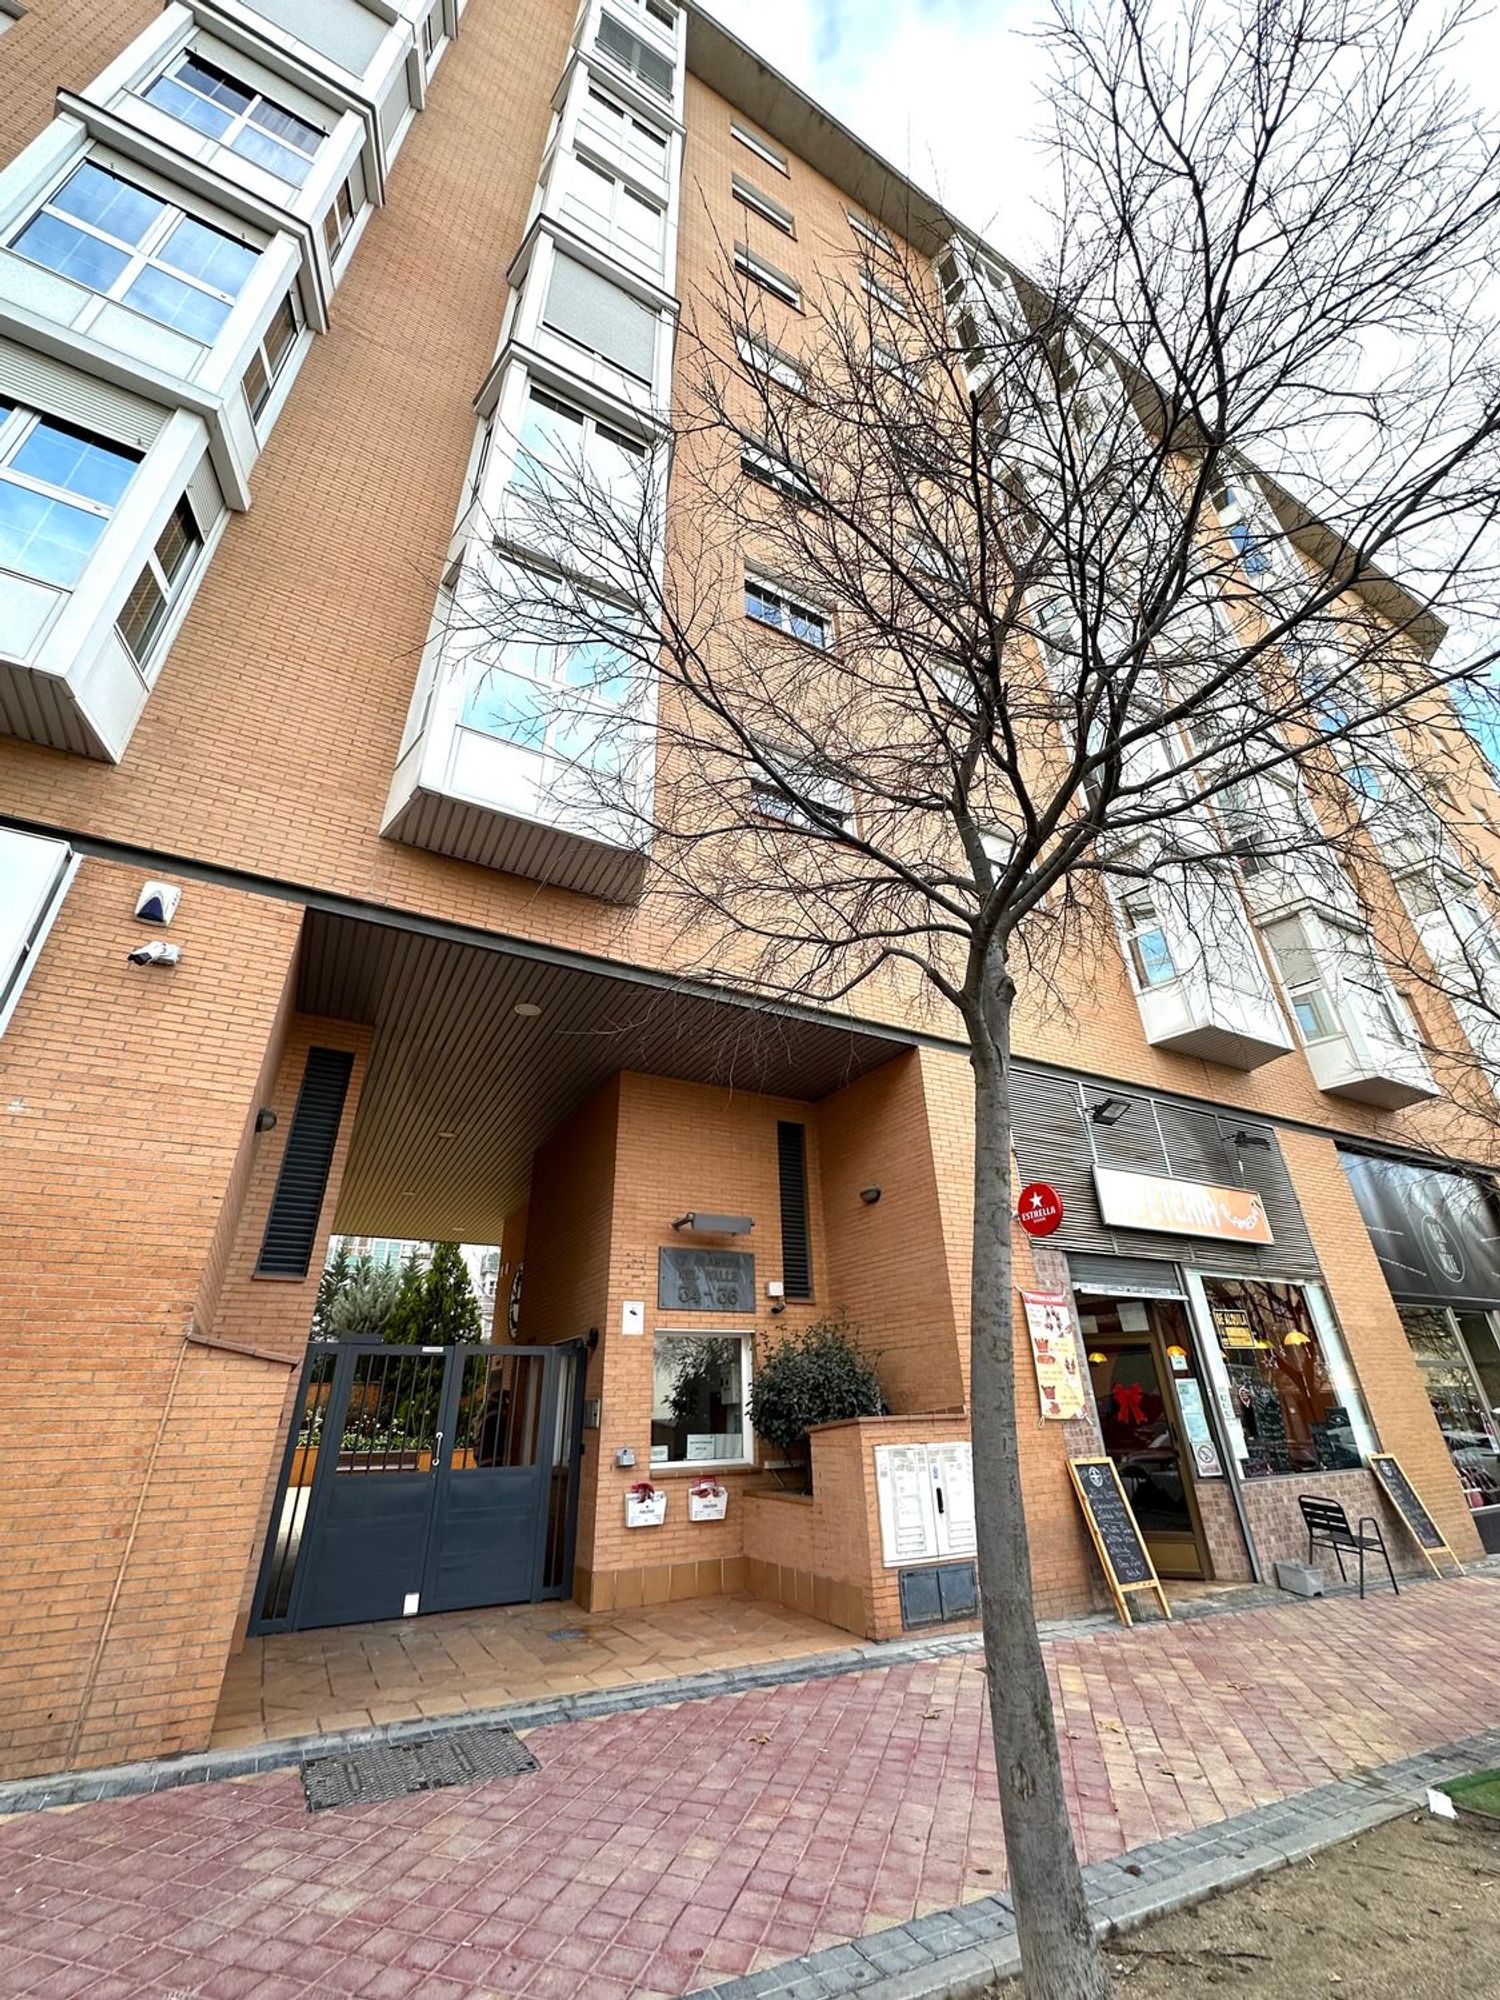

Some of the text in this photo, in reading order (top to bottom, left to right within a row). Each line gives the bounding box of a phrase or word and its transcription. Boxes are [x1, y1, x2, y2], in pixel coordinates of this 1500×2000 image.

[1021, 1206, 1056, 1221] ESTRELLA
[704, 1268, 738, 1283] VALLE
[716, 1287, 738, 1306] 36
